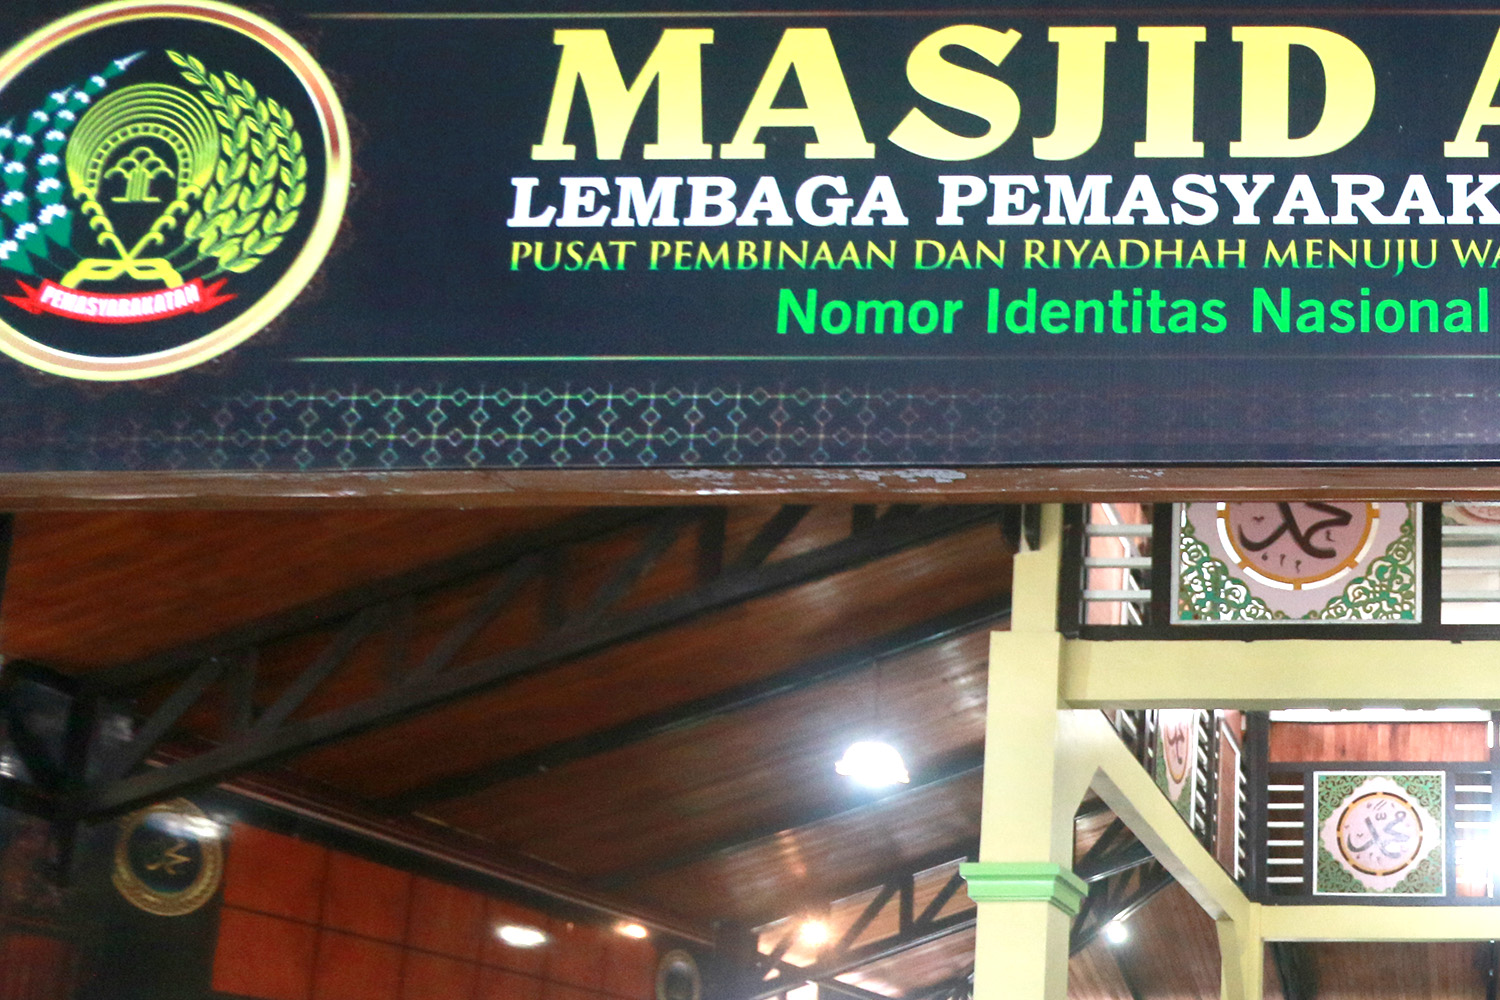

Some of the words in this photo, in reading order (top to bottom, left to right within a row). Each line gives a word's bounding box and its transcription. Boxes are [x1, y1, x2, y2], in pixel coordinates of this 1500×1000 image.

[530, 24, 1376, 162] MASJID
[506, 175, 910, 228] LEMBAGA
[509, 239, 637, 272] PUSAT
[649, 239, 898, 272] PEMBINAAN
[914, 239, 1007, 271] DAN
[1023, 239, 1248, 271] RIYADHAH
[1262, 239, 1440, 278] MENUJU
[776, 288, 964, 335] Nomor
[987, 287, 1228, 335] Identitas
[1253, 286, 1489, 334] Nasional
